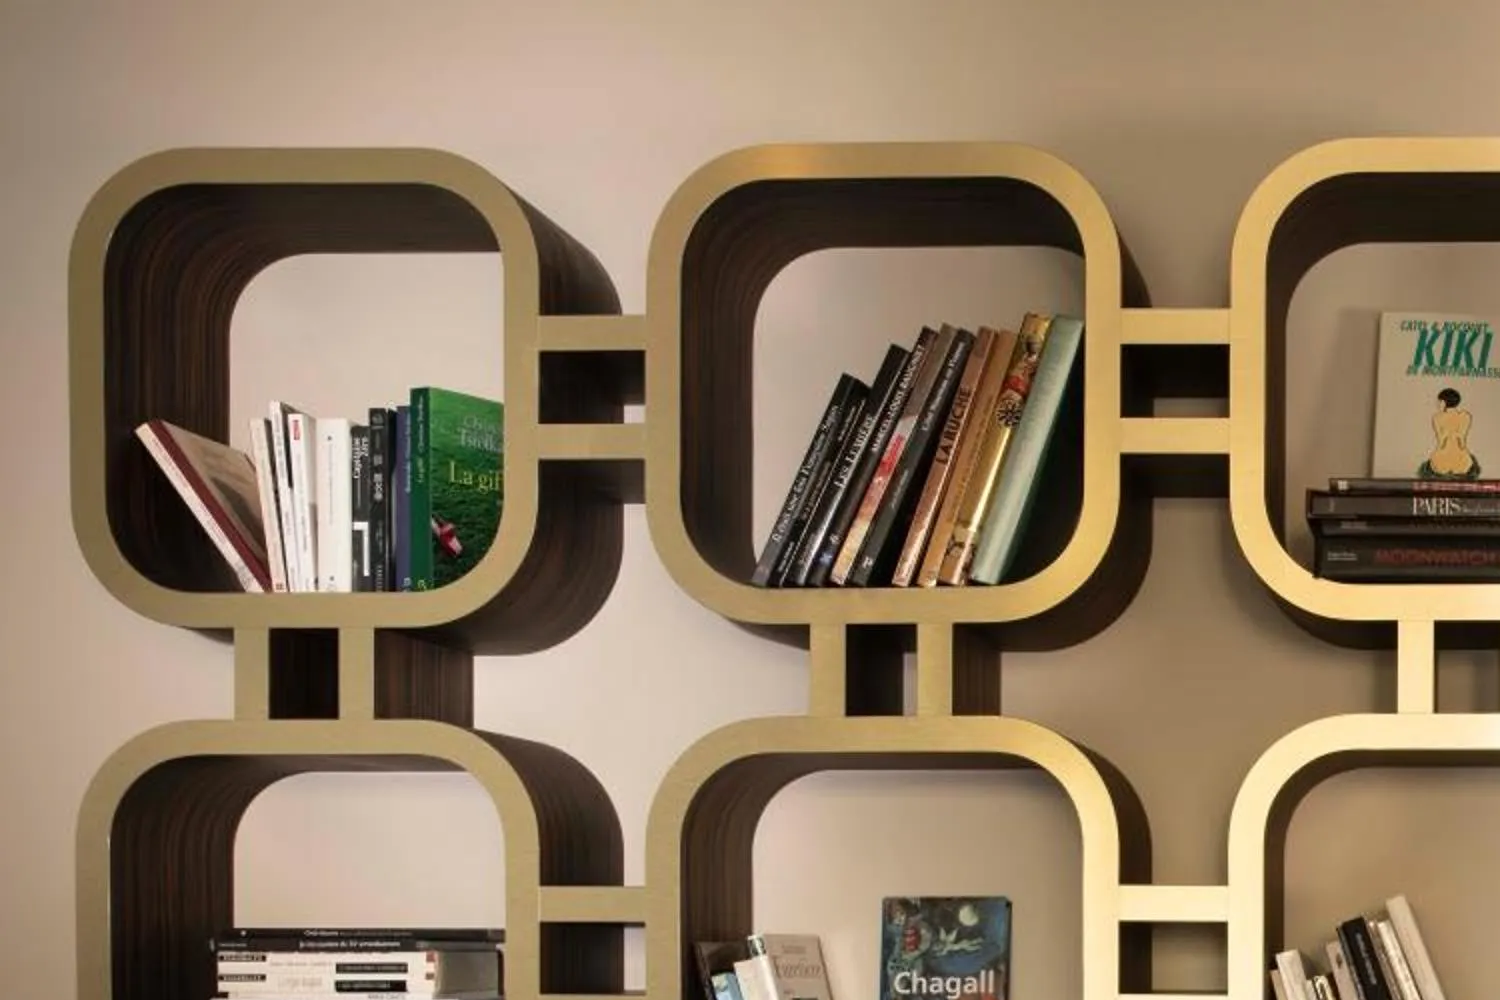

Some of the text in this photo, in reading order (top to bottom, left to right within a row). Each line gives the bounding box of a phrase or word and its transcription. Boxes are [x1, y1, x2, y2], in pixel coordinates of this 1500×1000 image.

[1413, 328, 1494, 370] KIKI
[448, 460, 473, 486] La
[1412, 497, 1461, 516] PARIS
[893, 969, 995, 1000] Chagall
